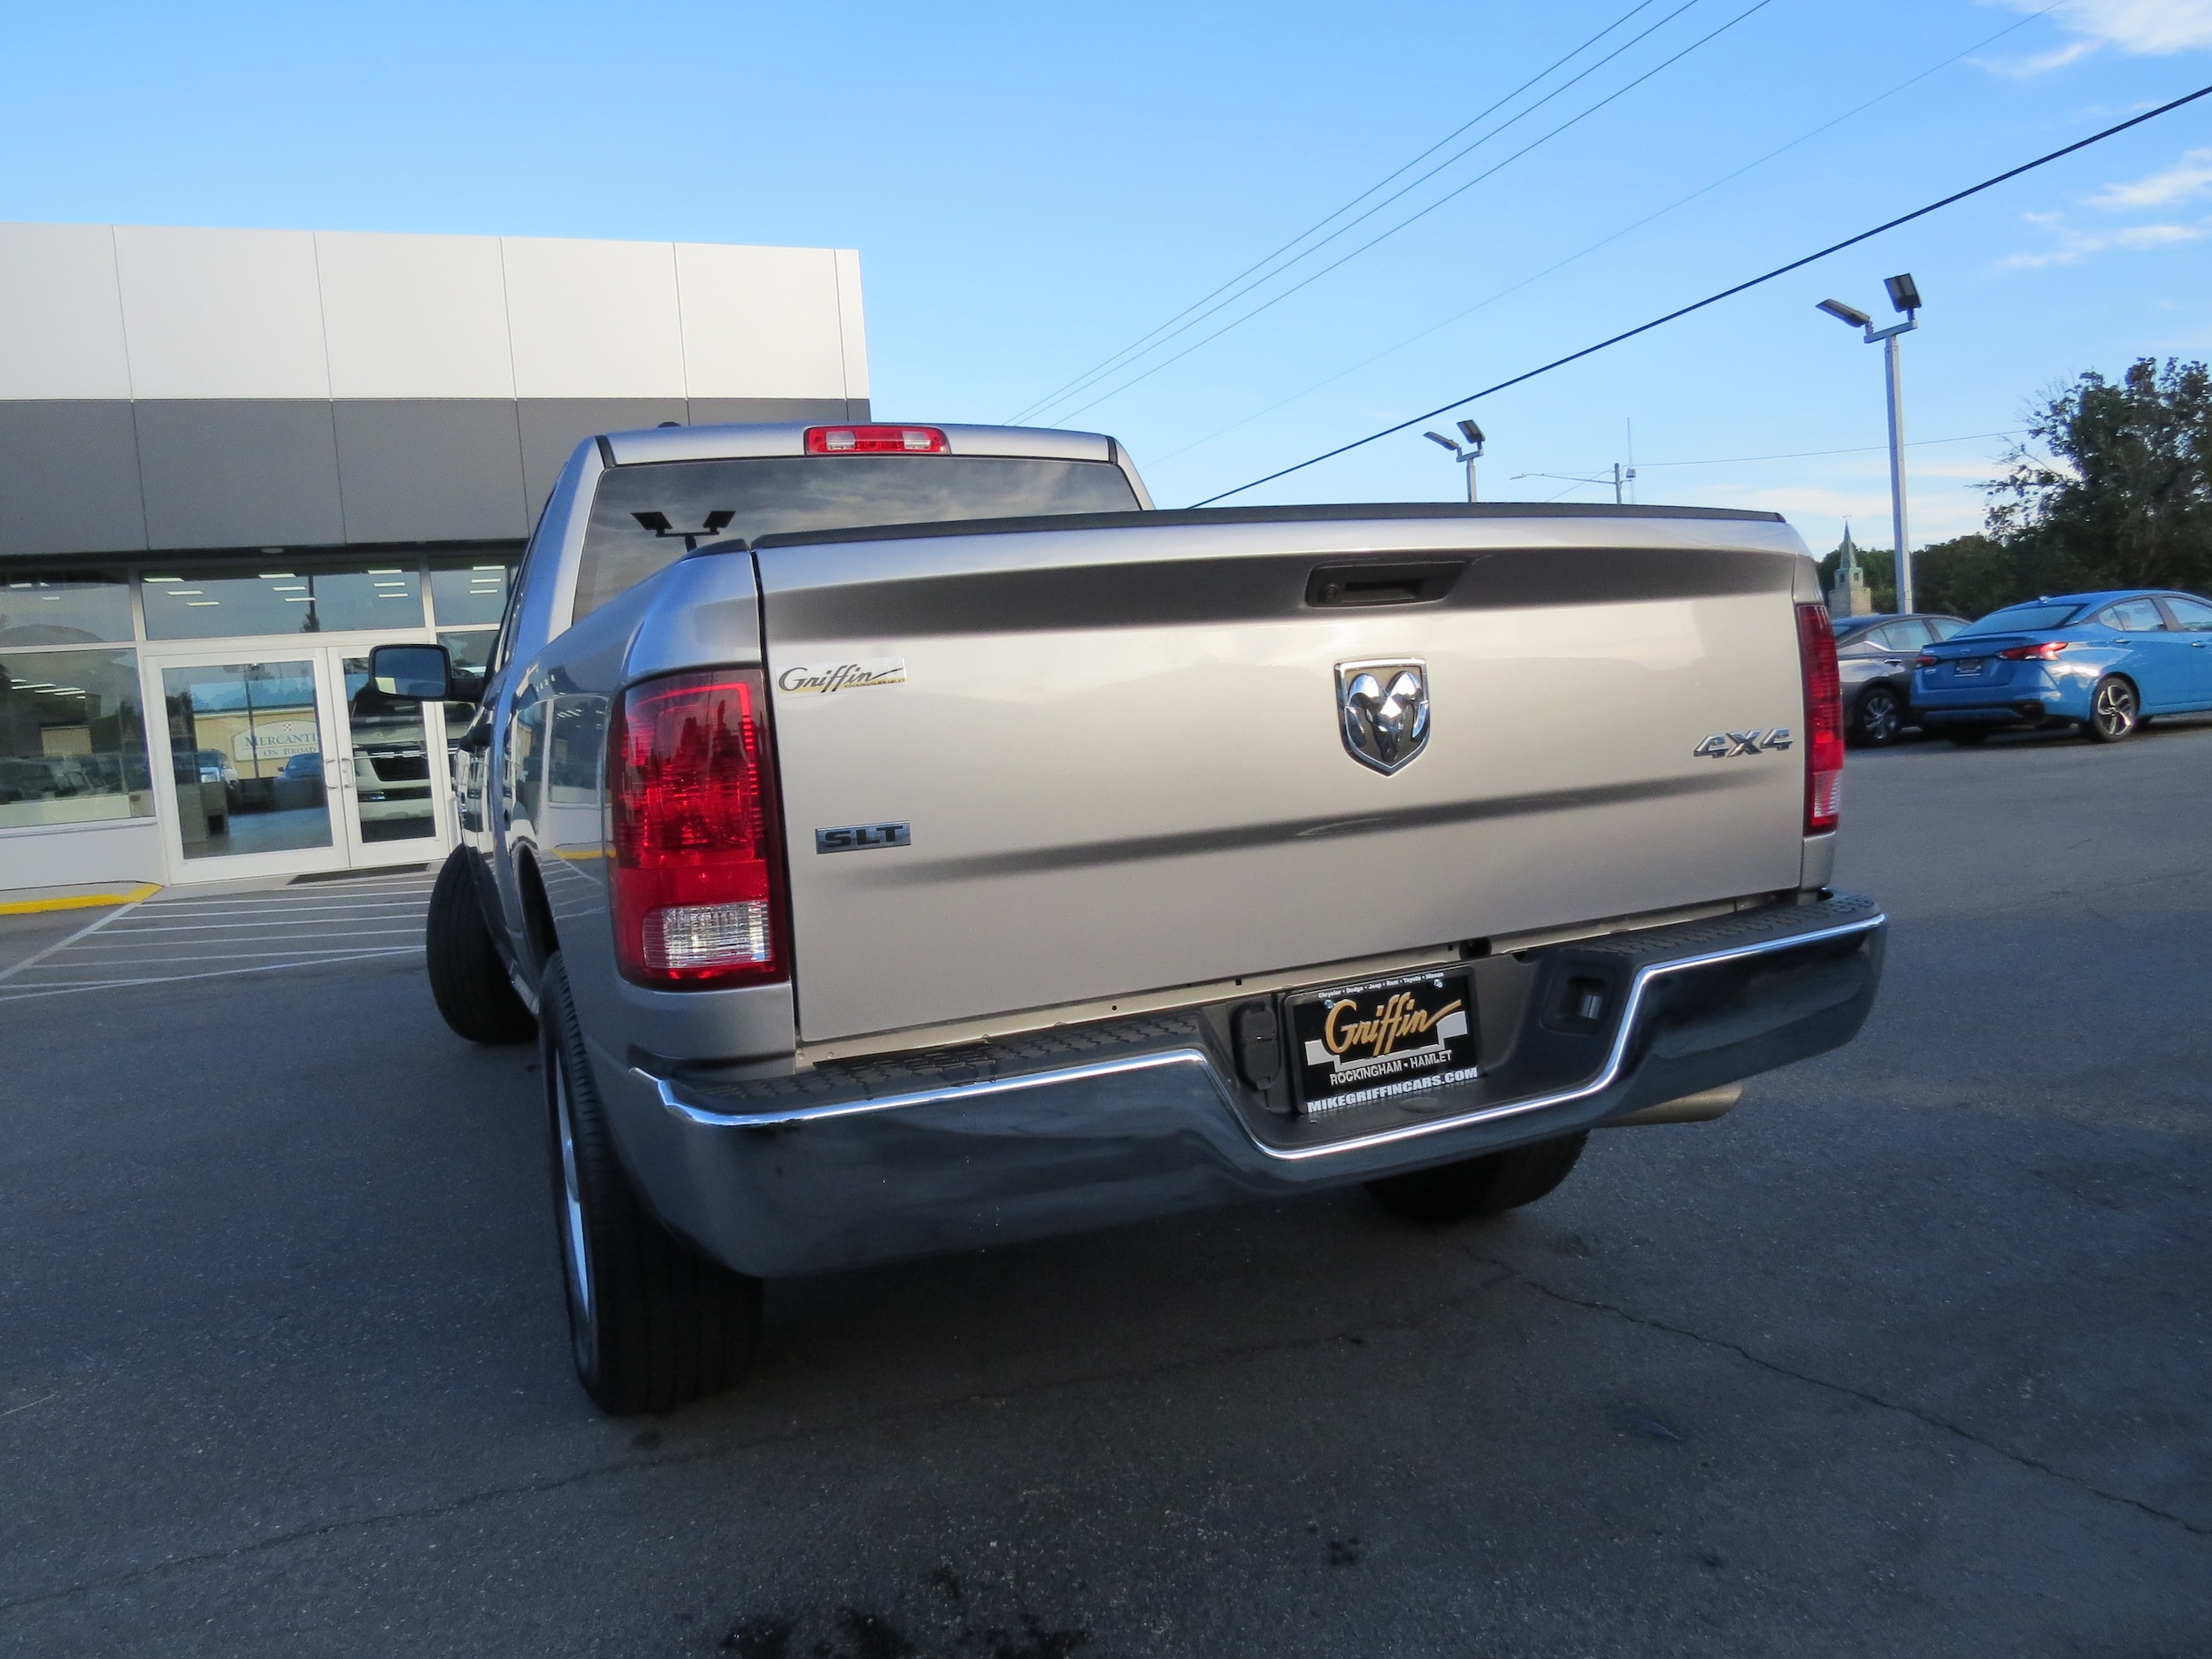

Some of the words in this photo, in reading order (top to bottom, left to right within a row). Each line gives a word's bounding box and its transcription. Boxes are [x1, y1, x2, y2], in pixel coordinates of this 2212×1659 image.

[778, 664, 903, 693] Griffin
[825, 825, 903, 848] SLT
[1317, 989, 1342, 998] Chrysler
[1346, 985, 1363, 994] Dodge
[1402, 975, 1422, 984] Toyota
[1325, 992, 1462, 1056] Griffin
[1329, 1061, 1402, 1086] ROCKINGHAM
[1409, 1049, 1453, 1069] HAMLET
[1307, 1066, 1479, 1114] MIKEGRIFFINCARS.COM
